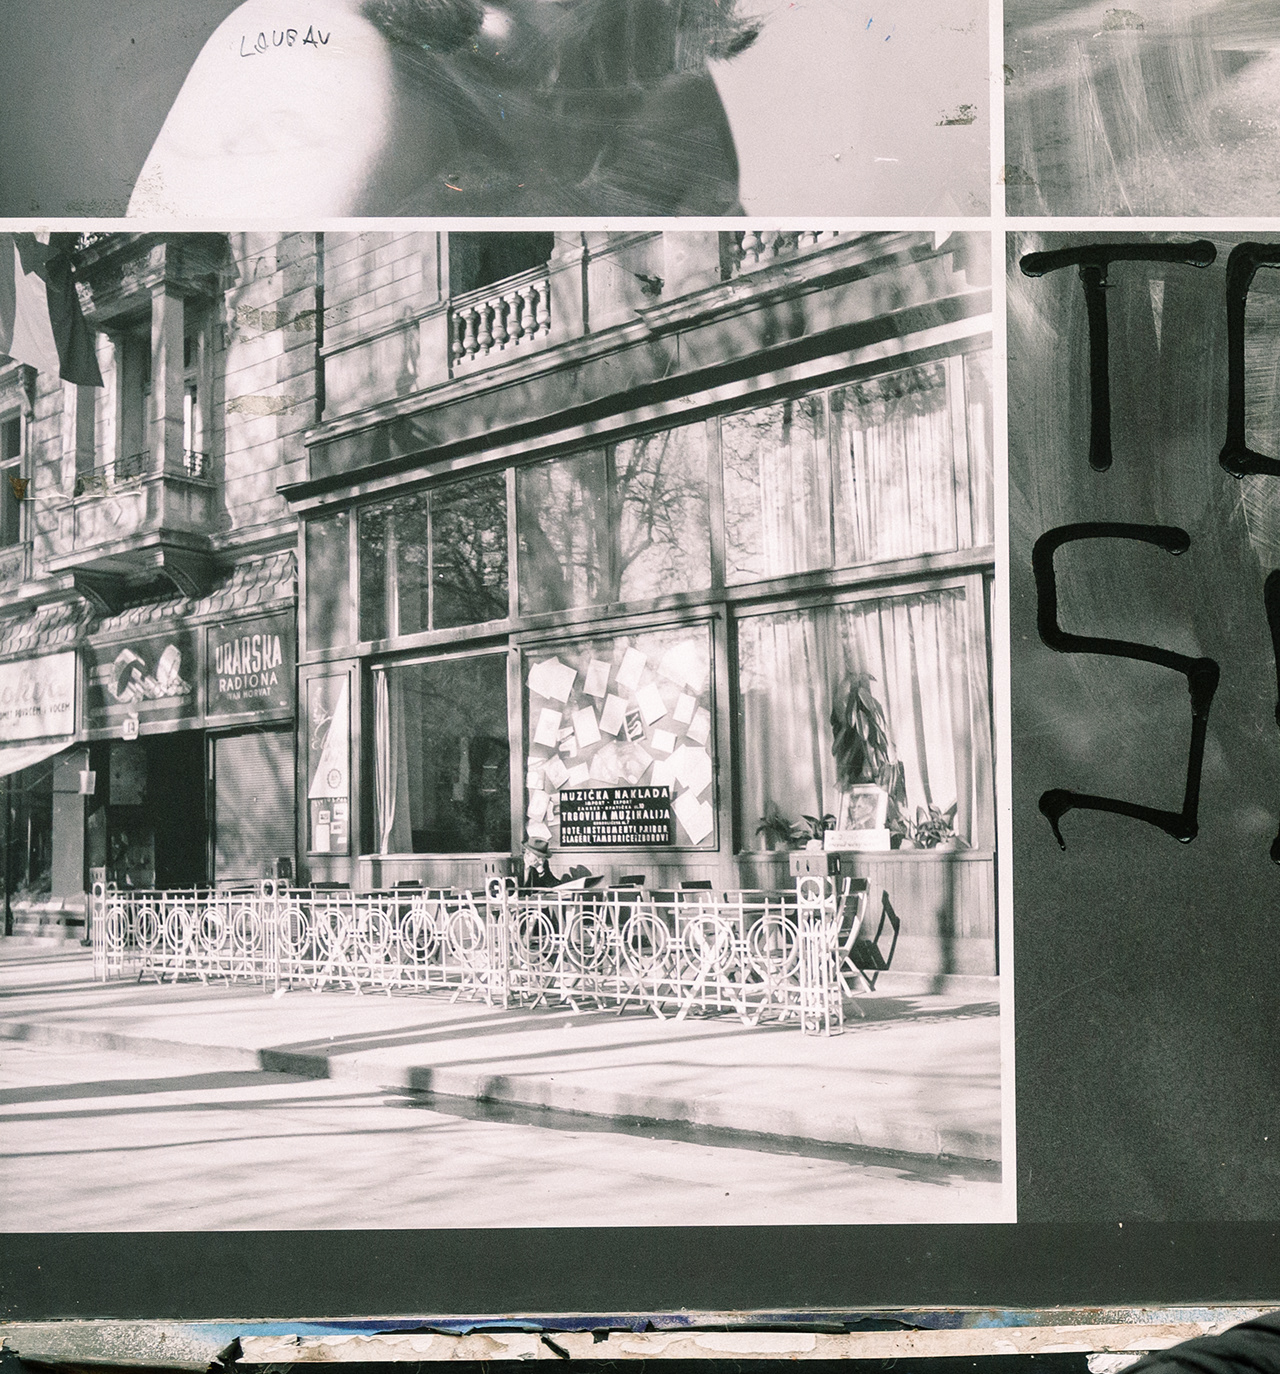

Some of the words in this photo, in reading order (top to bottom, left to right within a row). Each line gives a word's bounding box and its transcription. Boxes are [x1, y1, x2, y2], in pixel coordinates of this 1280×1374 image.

[219, 671, 278, 692] RADIONA
[561, 789, 610, 802] MUZIČKA
[614, 787, 670, 800] NAKLADA
[561, 811, 608, 821] TRGOVINA
